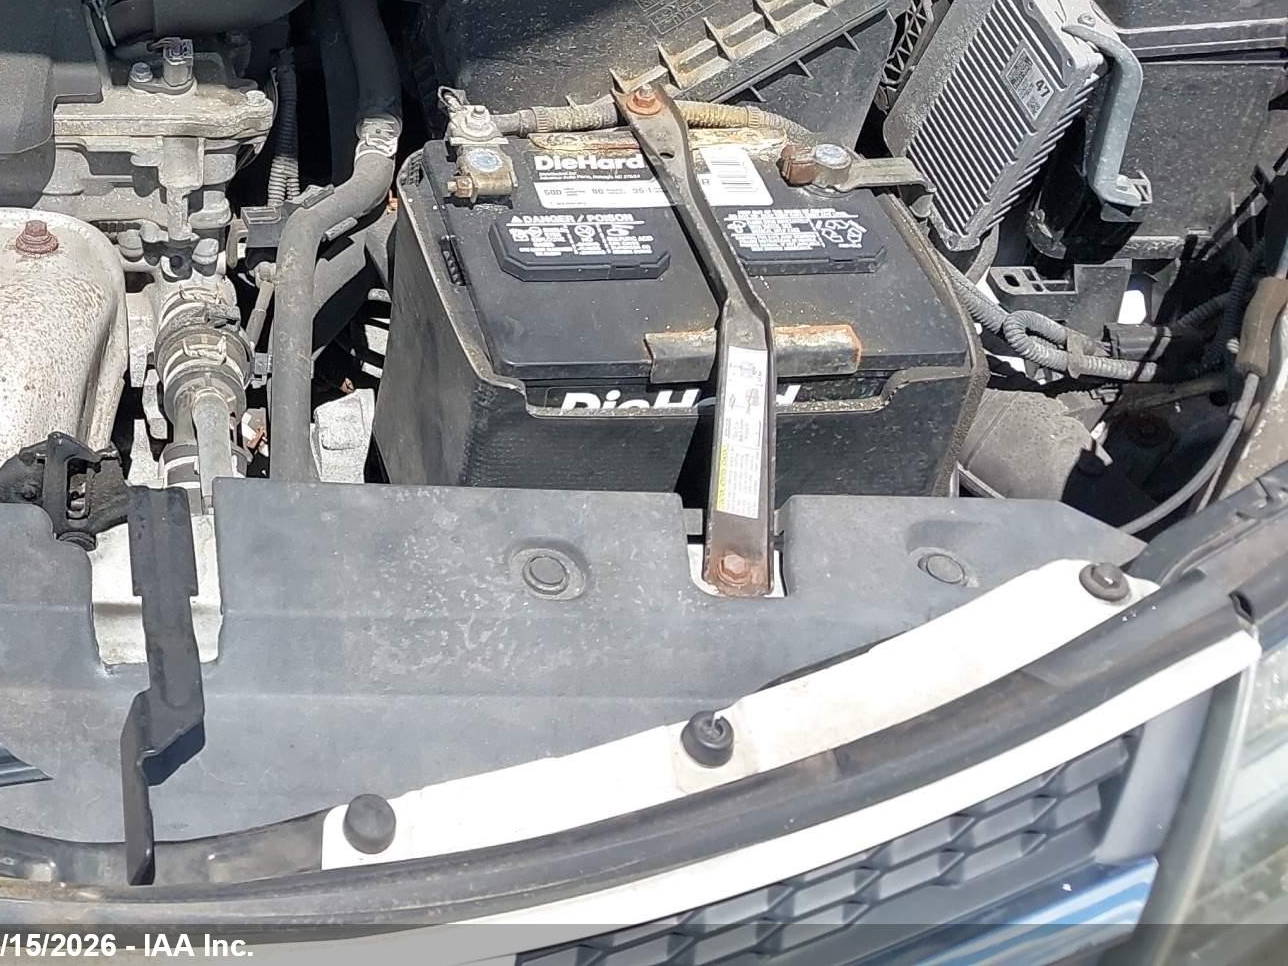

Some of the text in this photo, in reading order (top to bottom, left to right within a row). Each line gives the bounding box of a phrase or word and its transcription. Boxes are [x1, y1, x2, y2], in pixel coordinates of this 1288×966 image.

[1034, 79, 1051, 98] 47
[533, 153, 645, 171] DieHard
[522, 214, 576, 224] DANGER
[586, 213, 634, 223] POISON
[560, 384, 802, 412] DiHd
